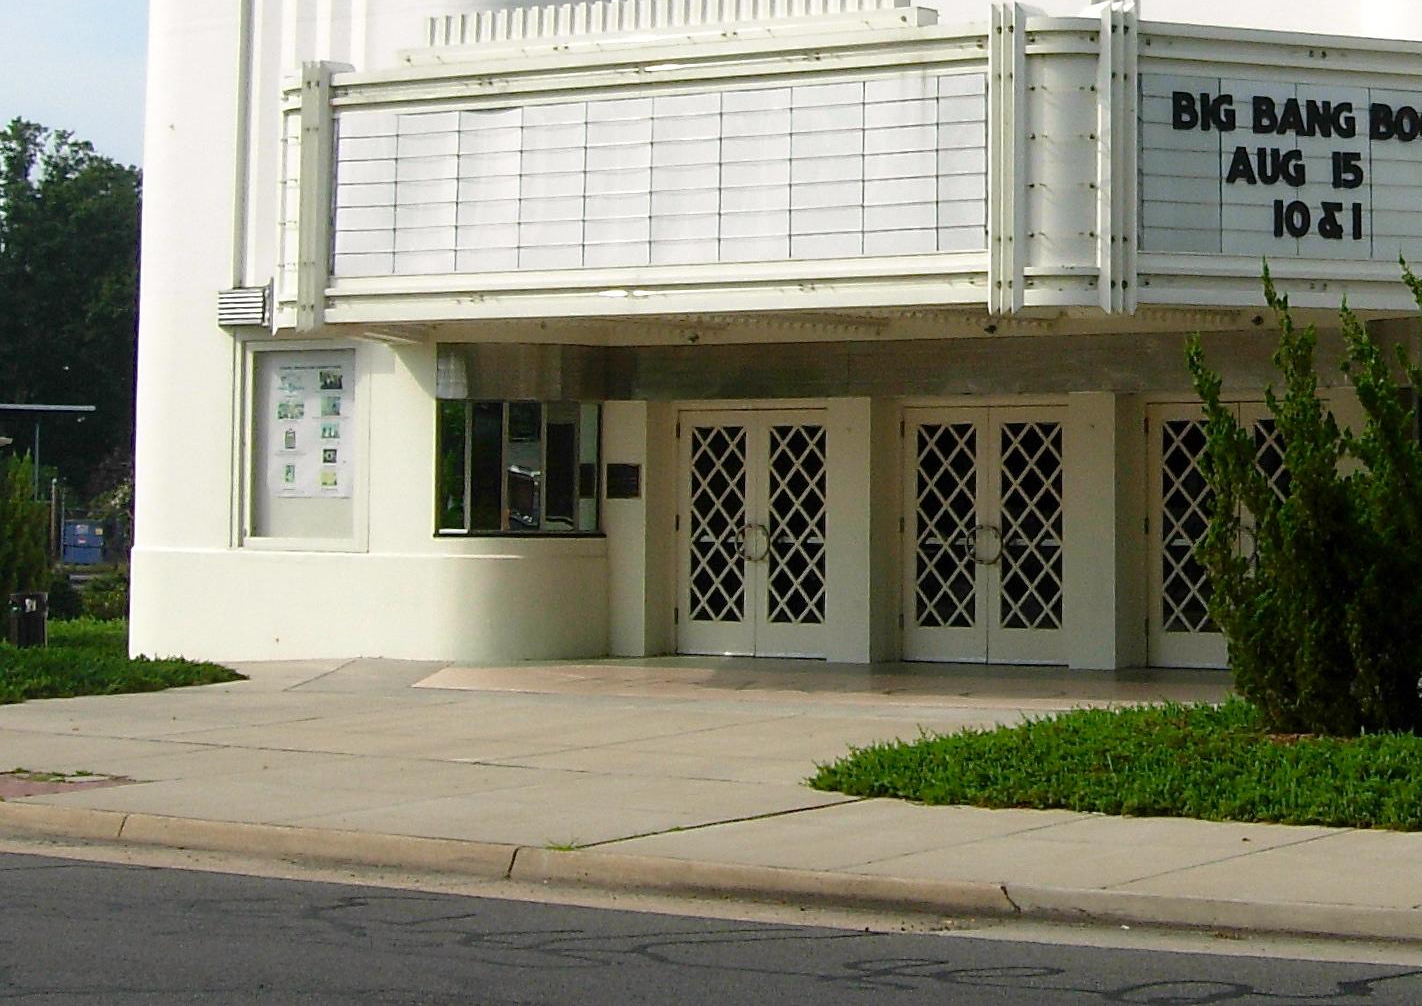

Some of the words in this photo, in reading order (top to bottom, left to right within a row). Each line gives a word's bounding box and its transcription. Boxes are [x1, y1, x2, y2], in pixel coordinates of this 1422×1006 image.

[1172, 91, 1236, 132] BIG
[1252, 95, 1356, 138] BANG
[1225, 146, 1306, 187] AUG
[1331, 151, 1364, 189] 15
